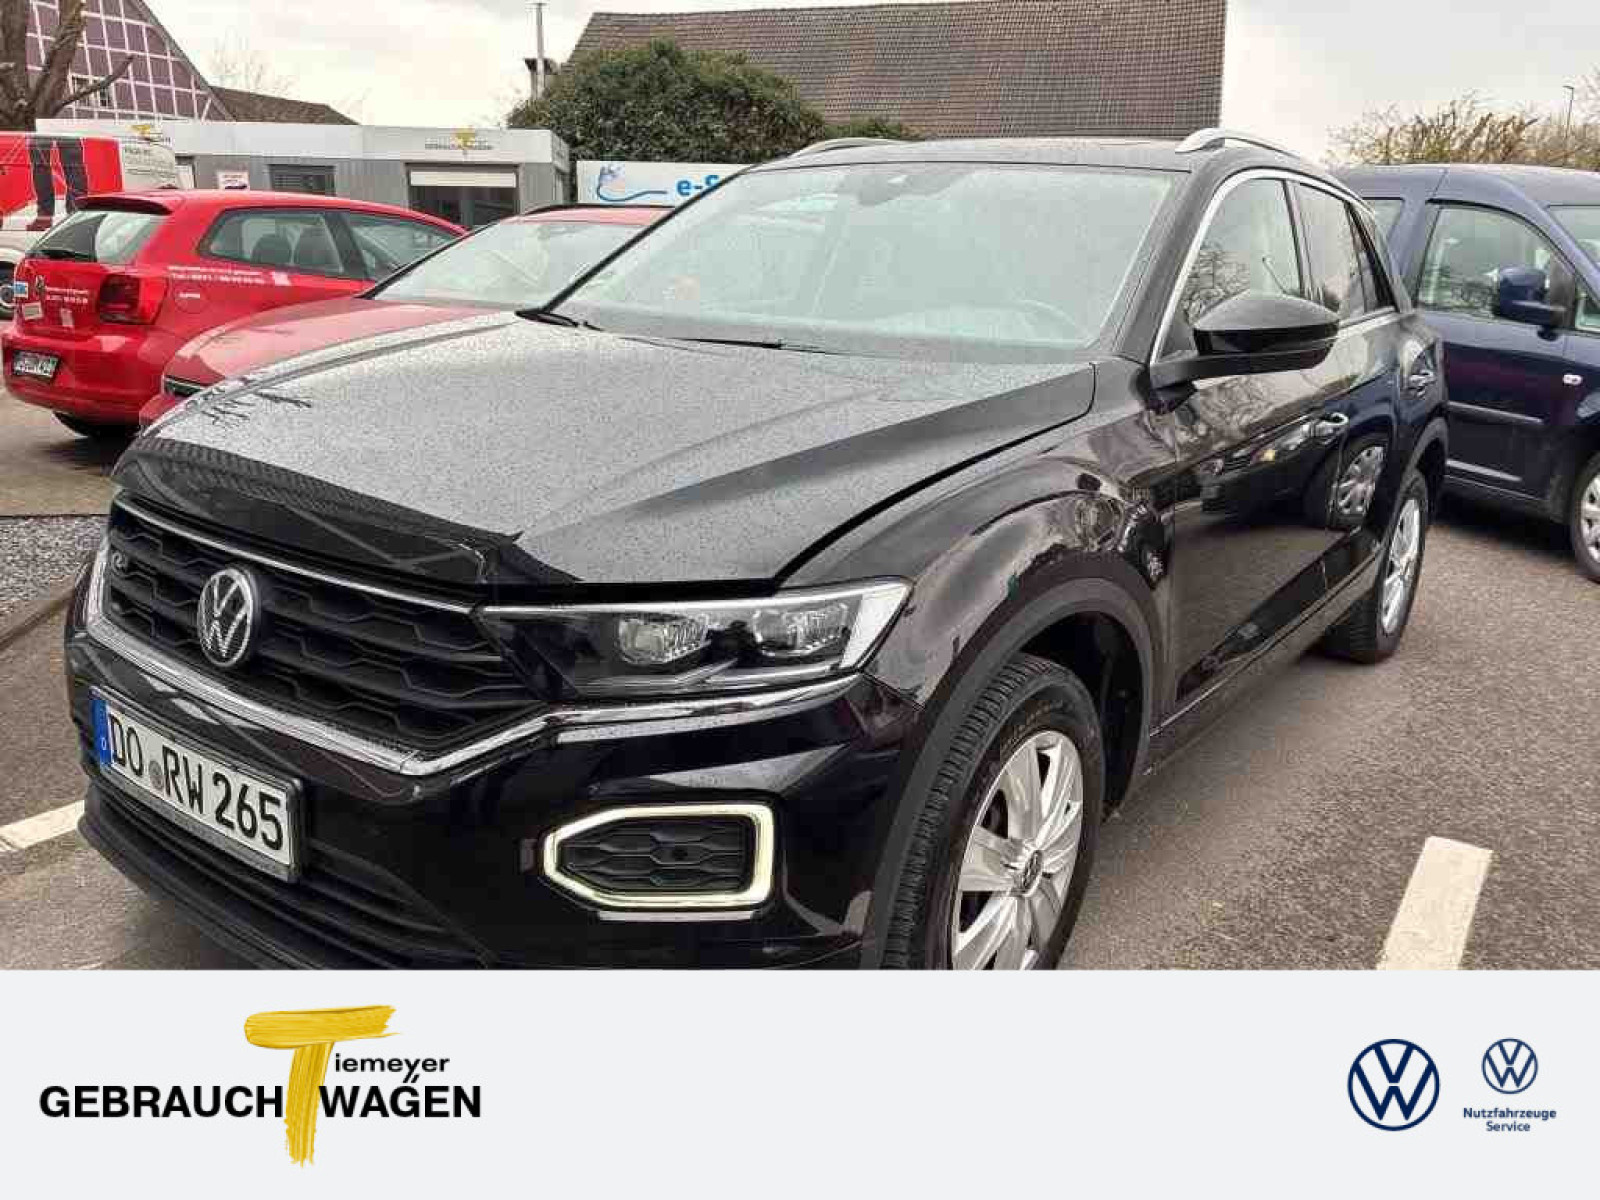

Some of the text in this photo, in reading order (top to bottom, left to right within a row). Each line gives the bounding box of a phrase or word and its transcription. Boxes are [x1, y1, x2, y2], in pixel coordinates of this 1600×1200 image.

[110, 714, 283, 850] DO RW 265
